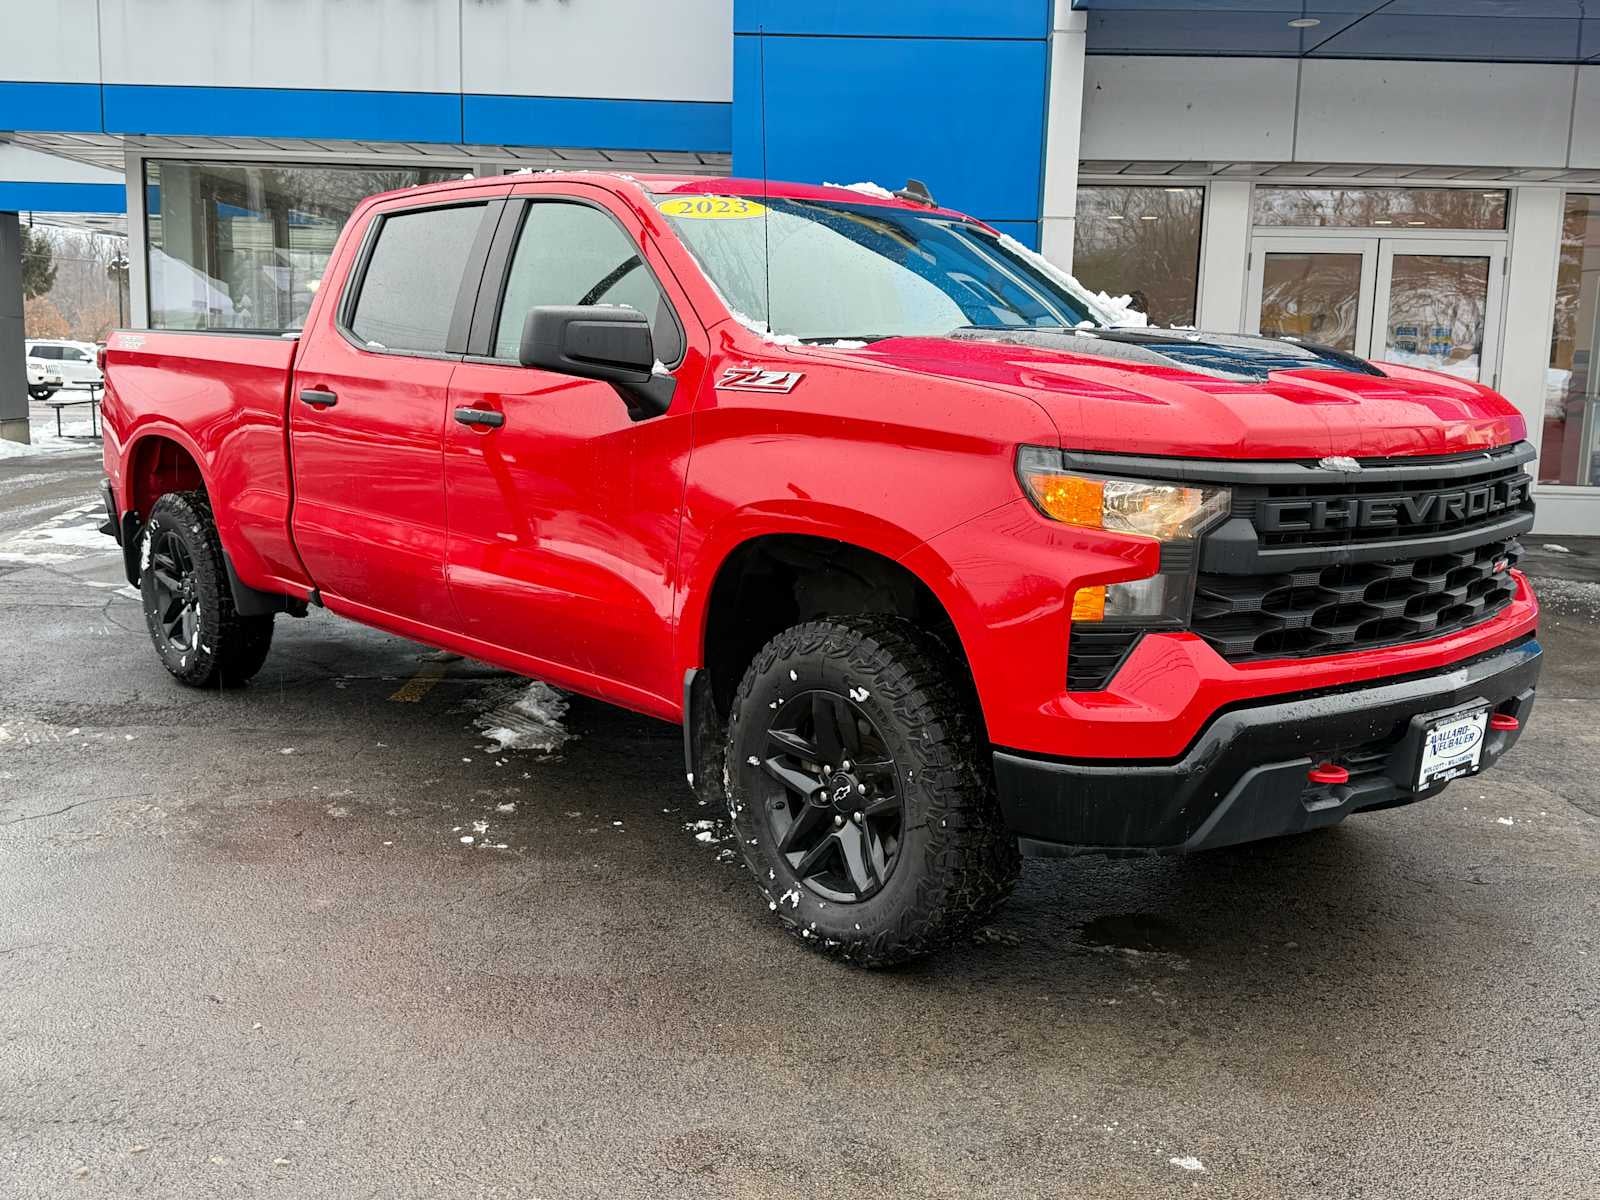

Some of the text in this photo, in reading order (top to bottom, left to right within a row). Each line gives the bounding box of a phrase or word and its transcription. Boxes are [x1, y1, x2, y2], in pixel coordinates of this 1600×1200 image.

[678, 200, 749, 214] 2023
[714, 367, 804, 394] Z71
[1263, 476, 1532, 530] CHEVROLET
